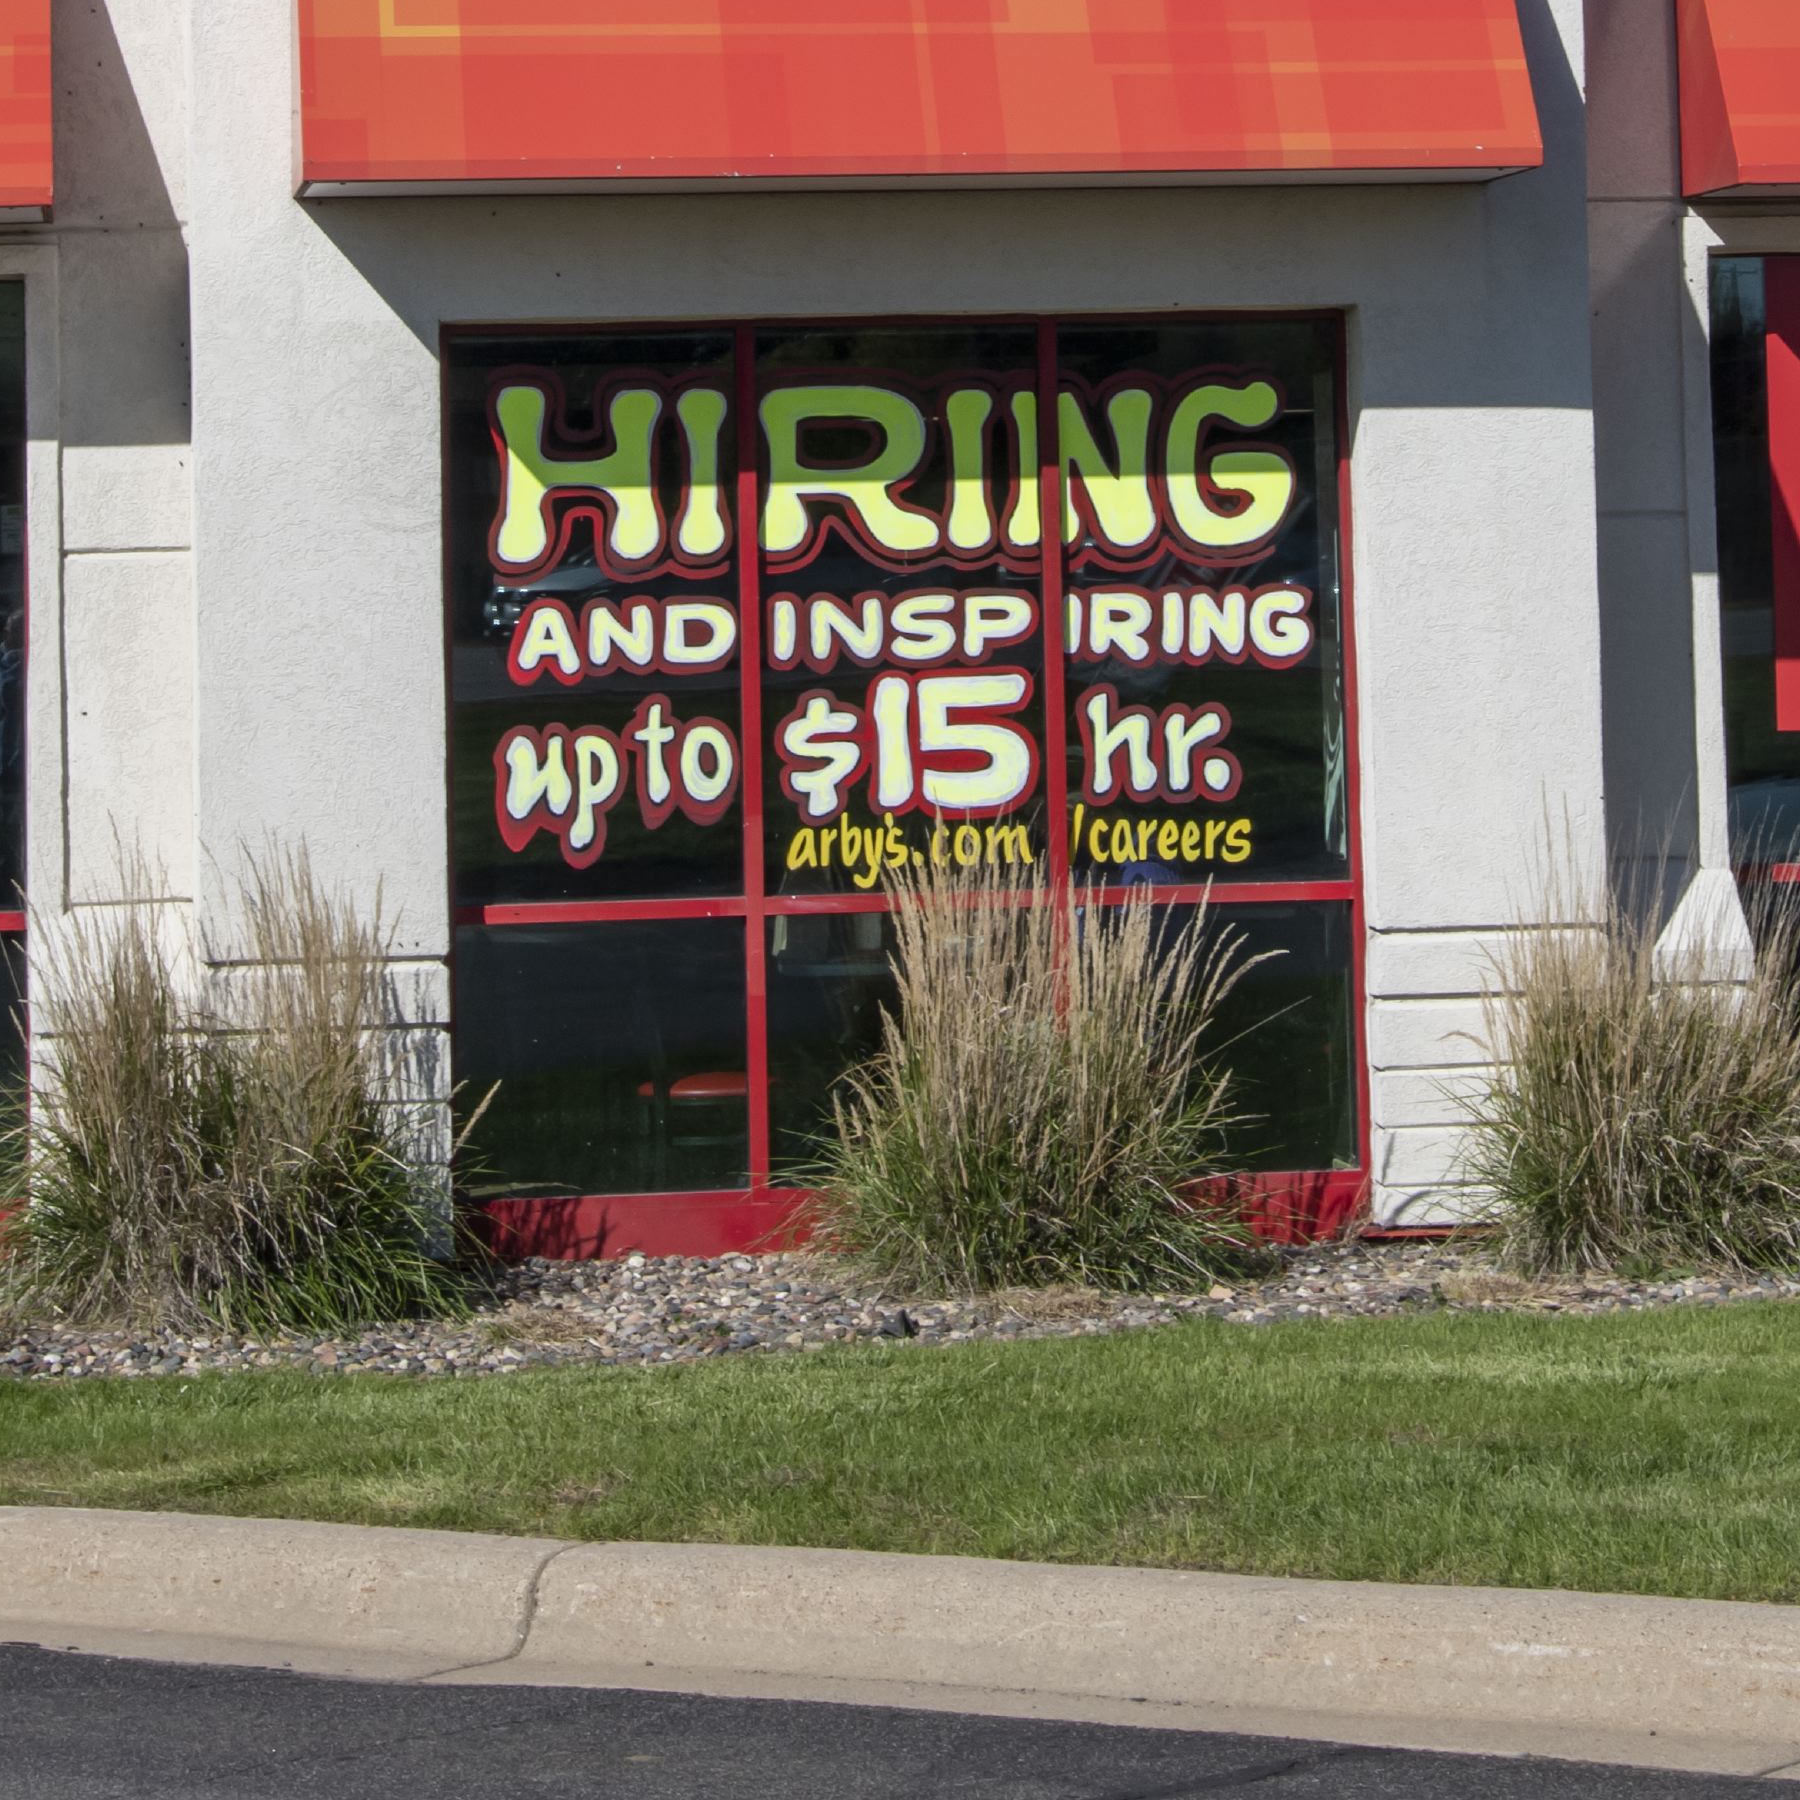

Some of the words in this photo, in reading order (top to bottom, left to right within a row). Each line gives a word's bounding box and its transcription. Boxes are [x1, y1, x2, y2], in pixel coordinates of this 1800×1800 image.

[494, 380, 1297, 565] HIRING
[517, 599, 738, 675] AND
[772, 588, 1313, 663] INSPIRING
[784, 672, 1033, 820] $15
[1090, 692, 1232, 797] hr.
